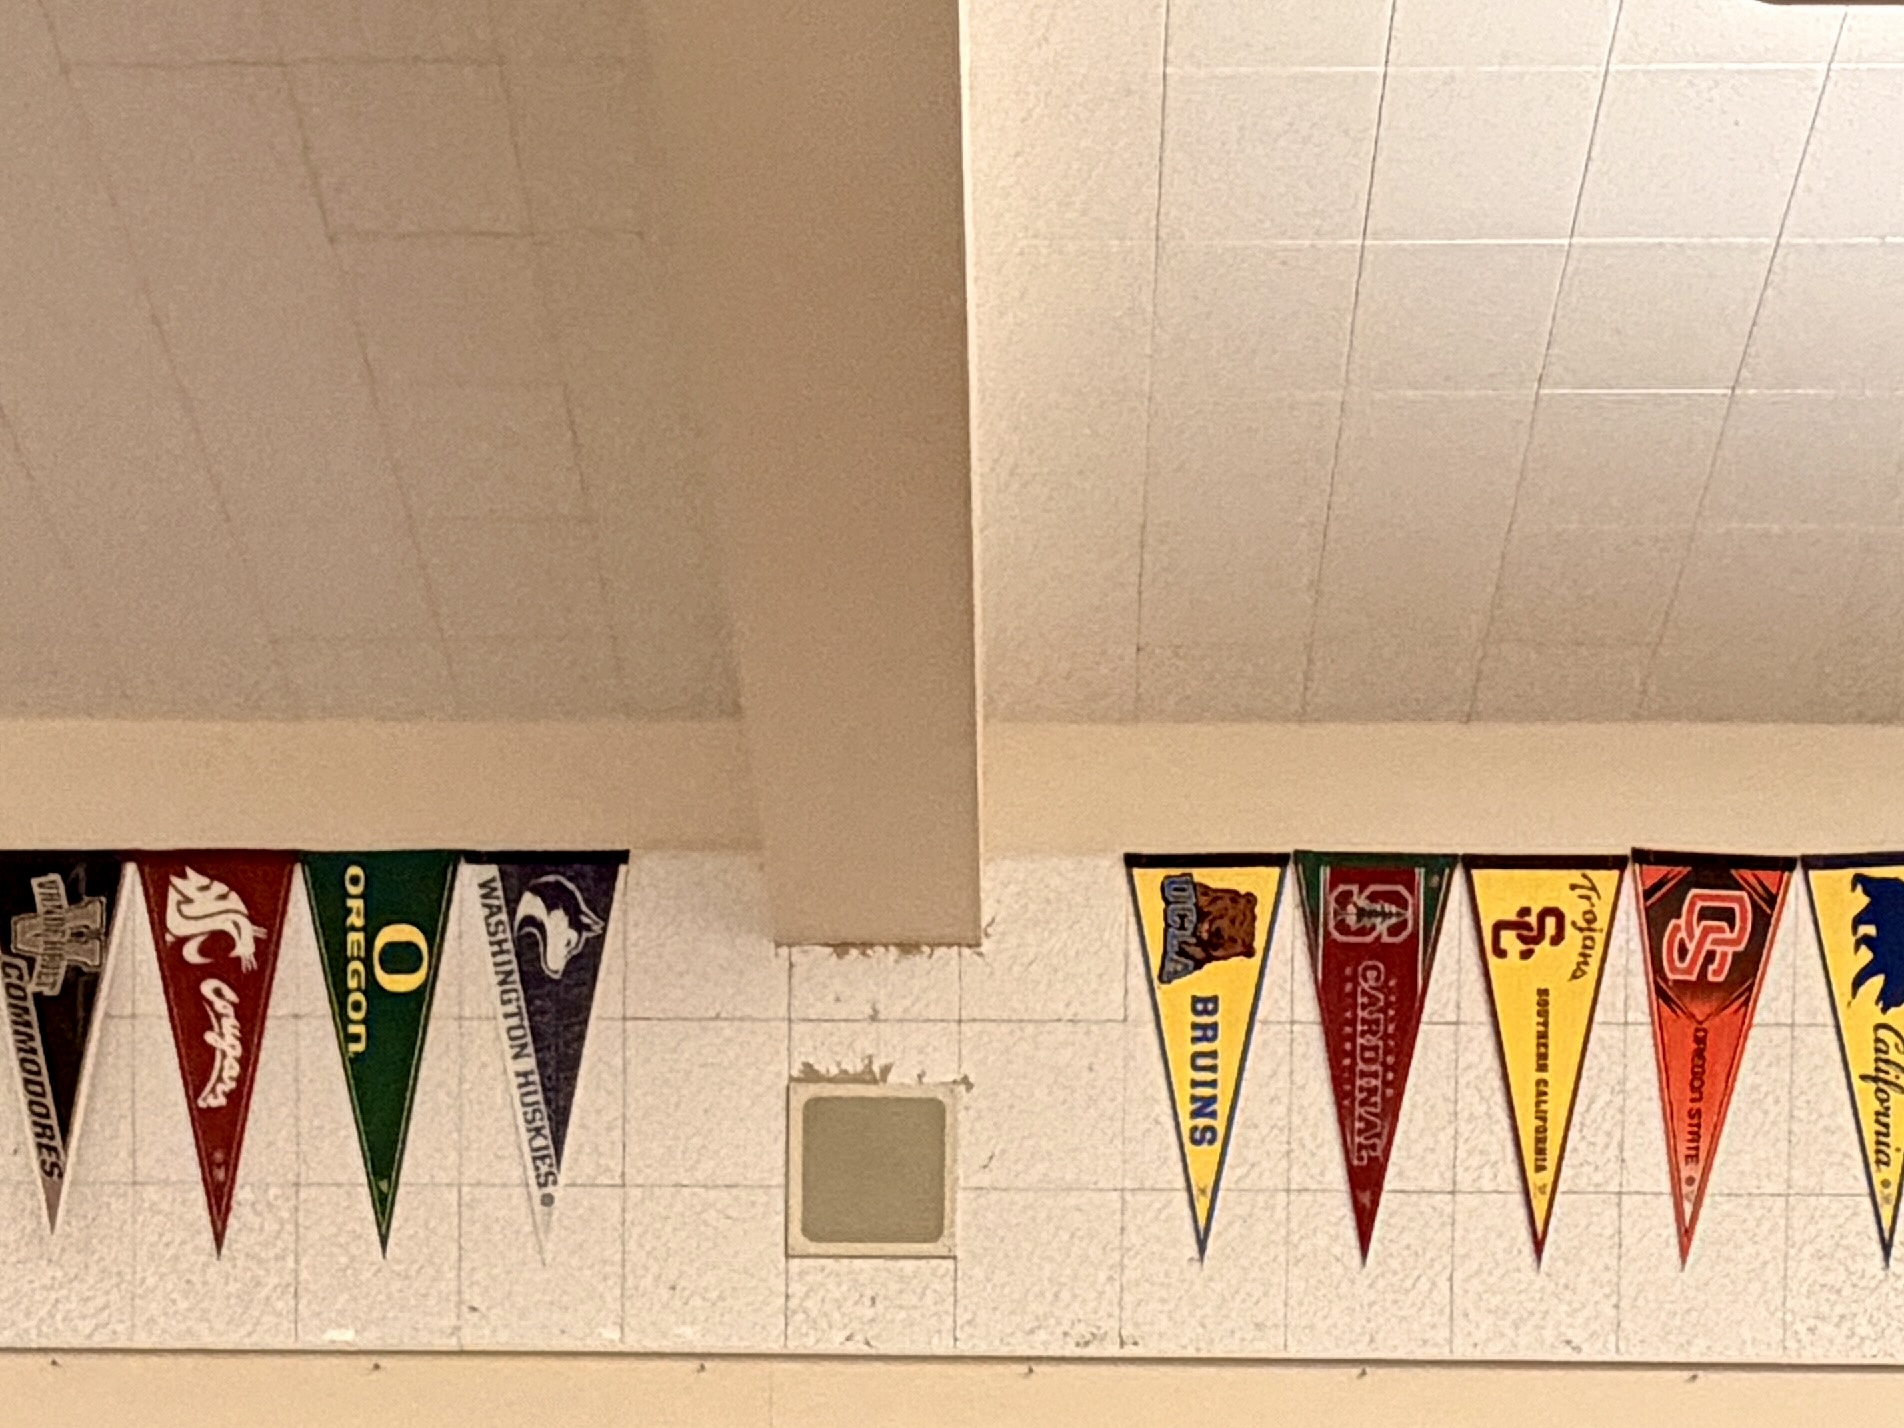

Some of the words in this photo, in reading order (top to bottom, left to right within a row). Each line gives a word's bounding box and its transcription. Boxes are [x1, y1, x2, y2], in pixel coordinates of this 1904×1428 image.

[345, 865, 368, 1056] OREGON
[373, 923, 430, 994] O
[1158, 874, 1196, 984] UCLA
[1568, 871, 1605, 982] Trojans
[0, 955, 64, 1182] COMMODORES
[199, 979, 243, 1109] Cougars
[477, 875, 531, 1064] WASHINGTON
[516, 1067, 559, 1190] HUSKIES
[1190, 994, 1219, 1149] BRUINS
[1352, 961, 1388, 1167] CARDINAL
[1536, 988, 1551, 1076] SOUTHERN
[1693, 1026, 1708, 1104] OREGON
[1535, 1078, 1550, 1174] CALIFORNIA
[1687, 1107, 1704, 1166] STATE
